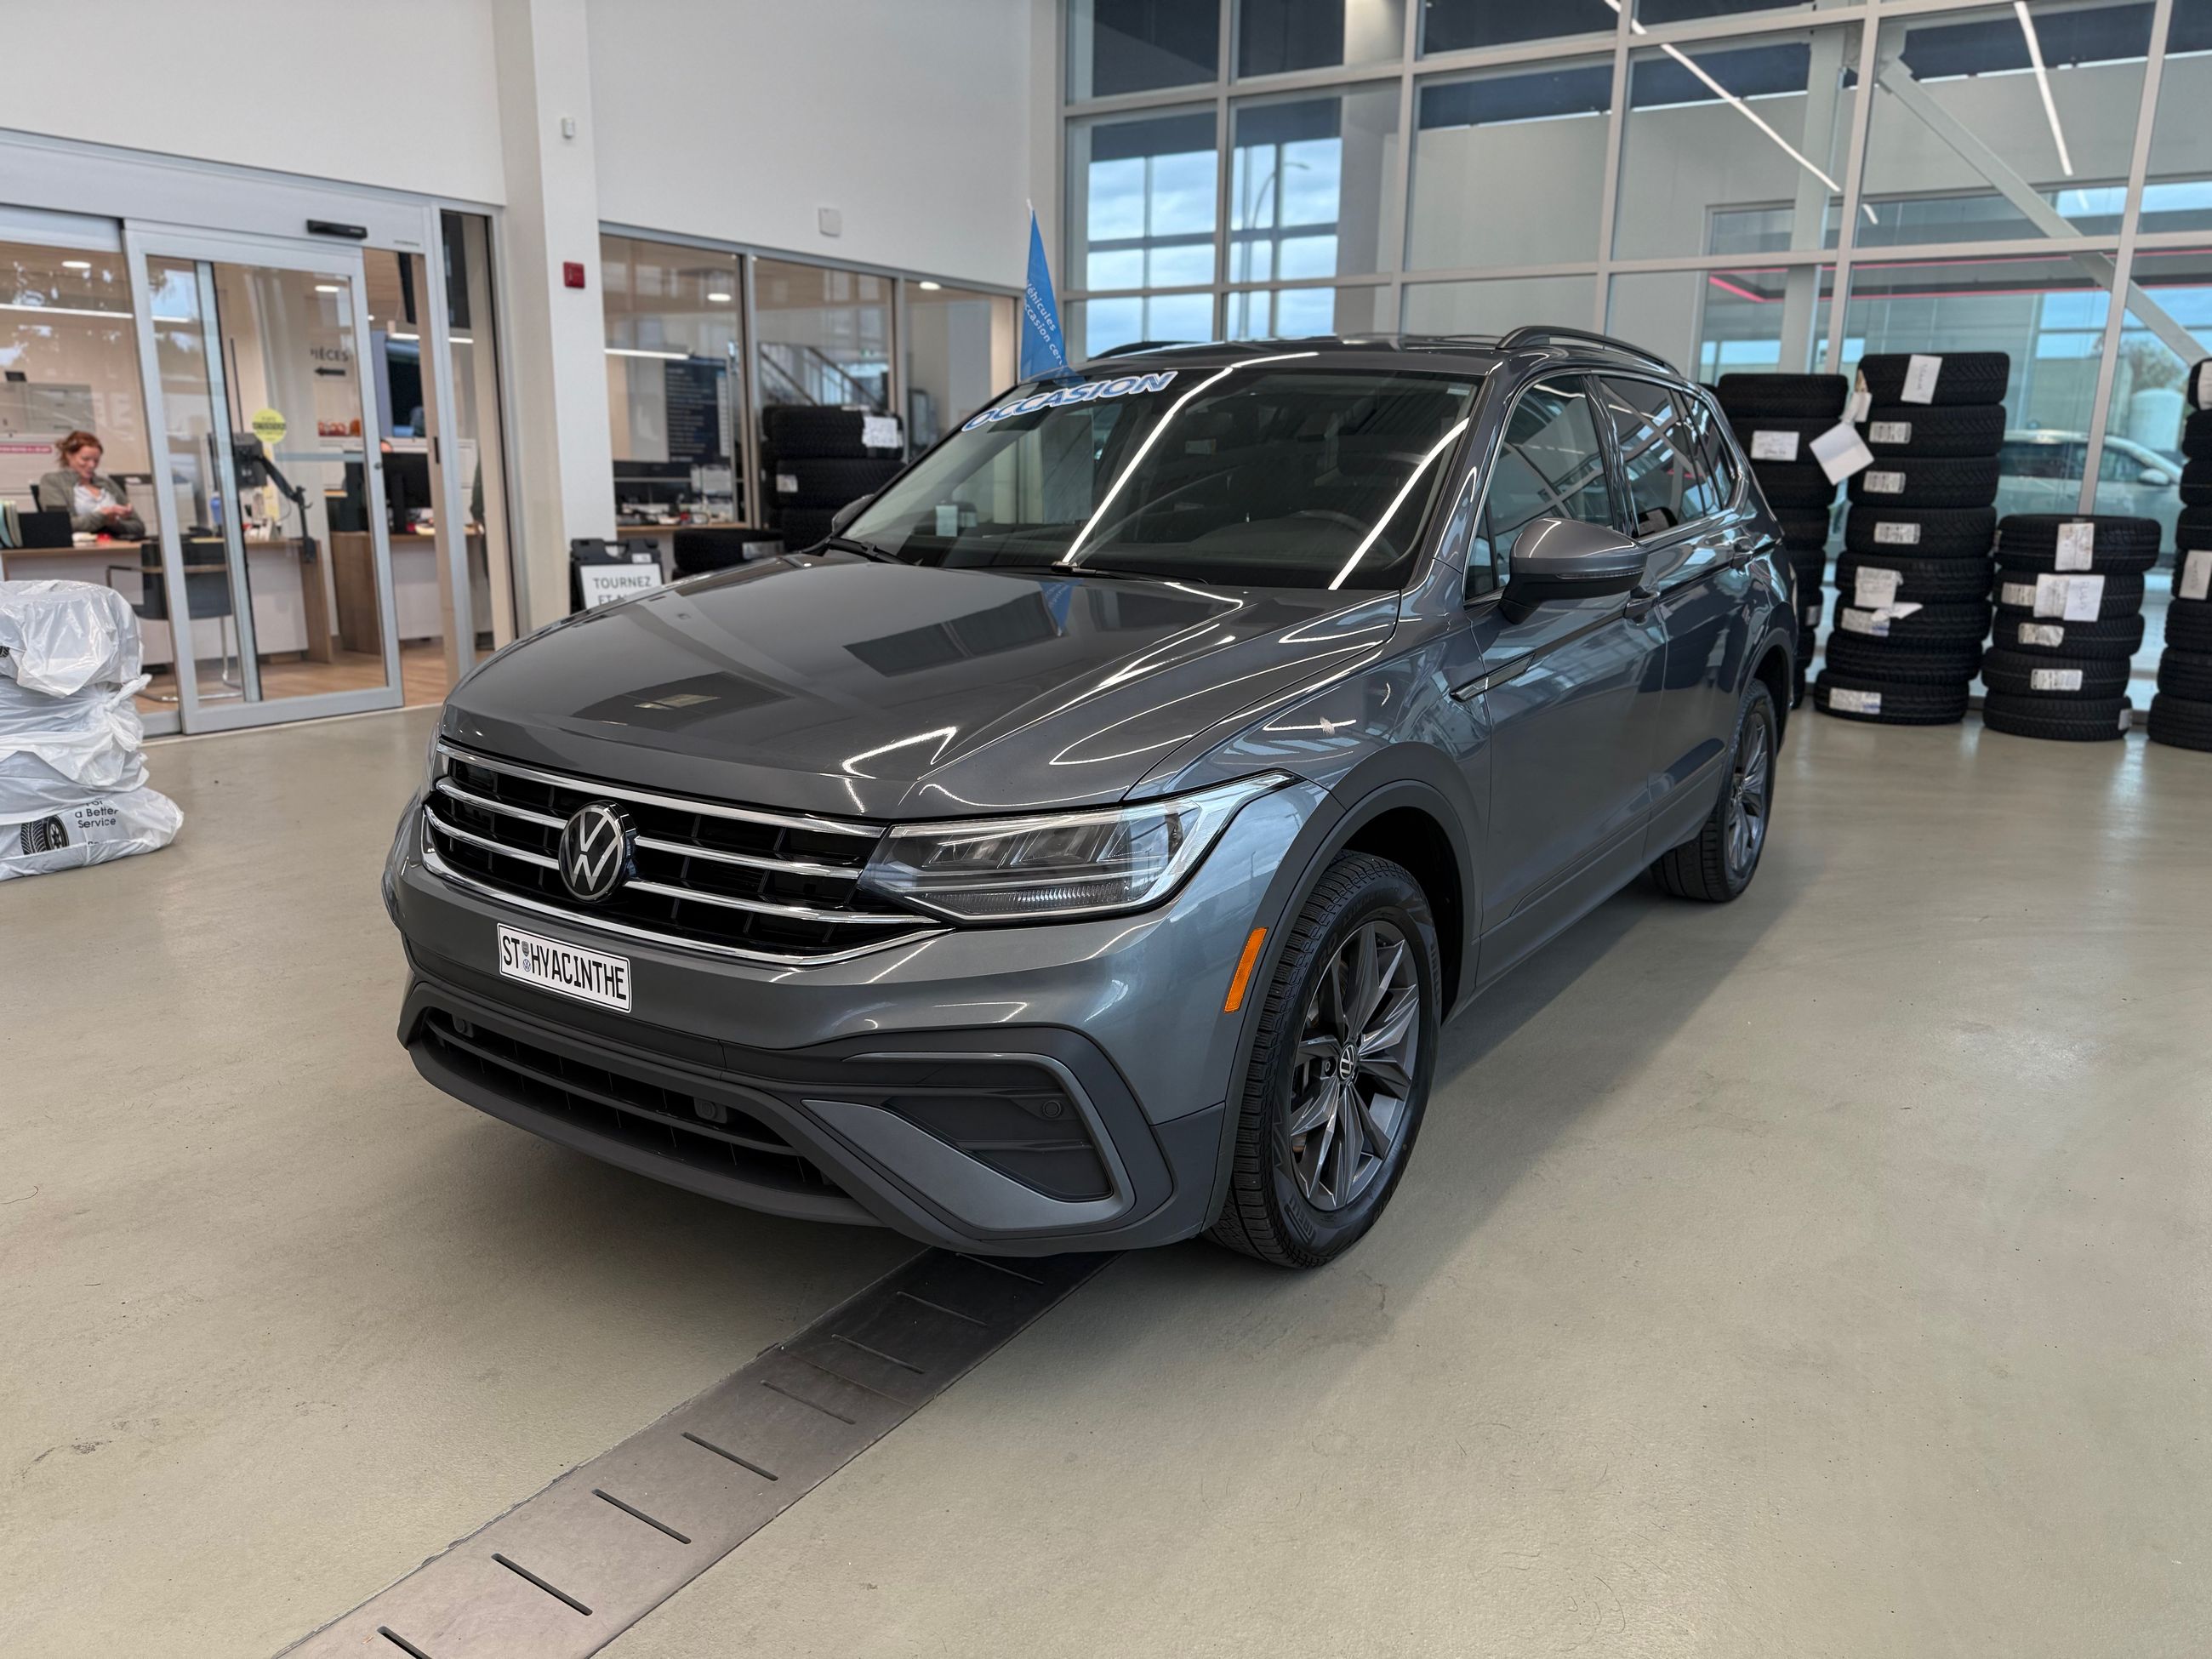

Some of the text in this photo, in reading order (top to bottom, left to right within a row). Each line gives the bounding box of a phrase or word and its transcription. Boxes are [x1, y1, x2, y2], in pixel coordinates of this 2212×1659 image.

[1024, 299, 1052, 342] ccasion
[961, 371, 1179, 432] OCCASION
[592, 575, 652, 589] TOURNEZ
[77, 818, 116, 828] Service
[86, 807, 119, 817] Better
[503, 935, 626, 1001] ST HYACINTHE
